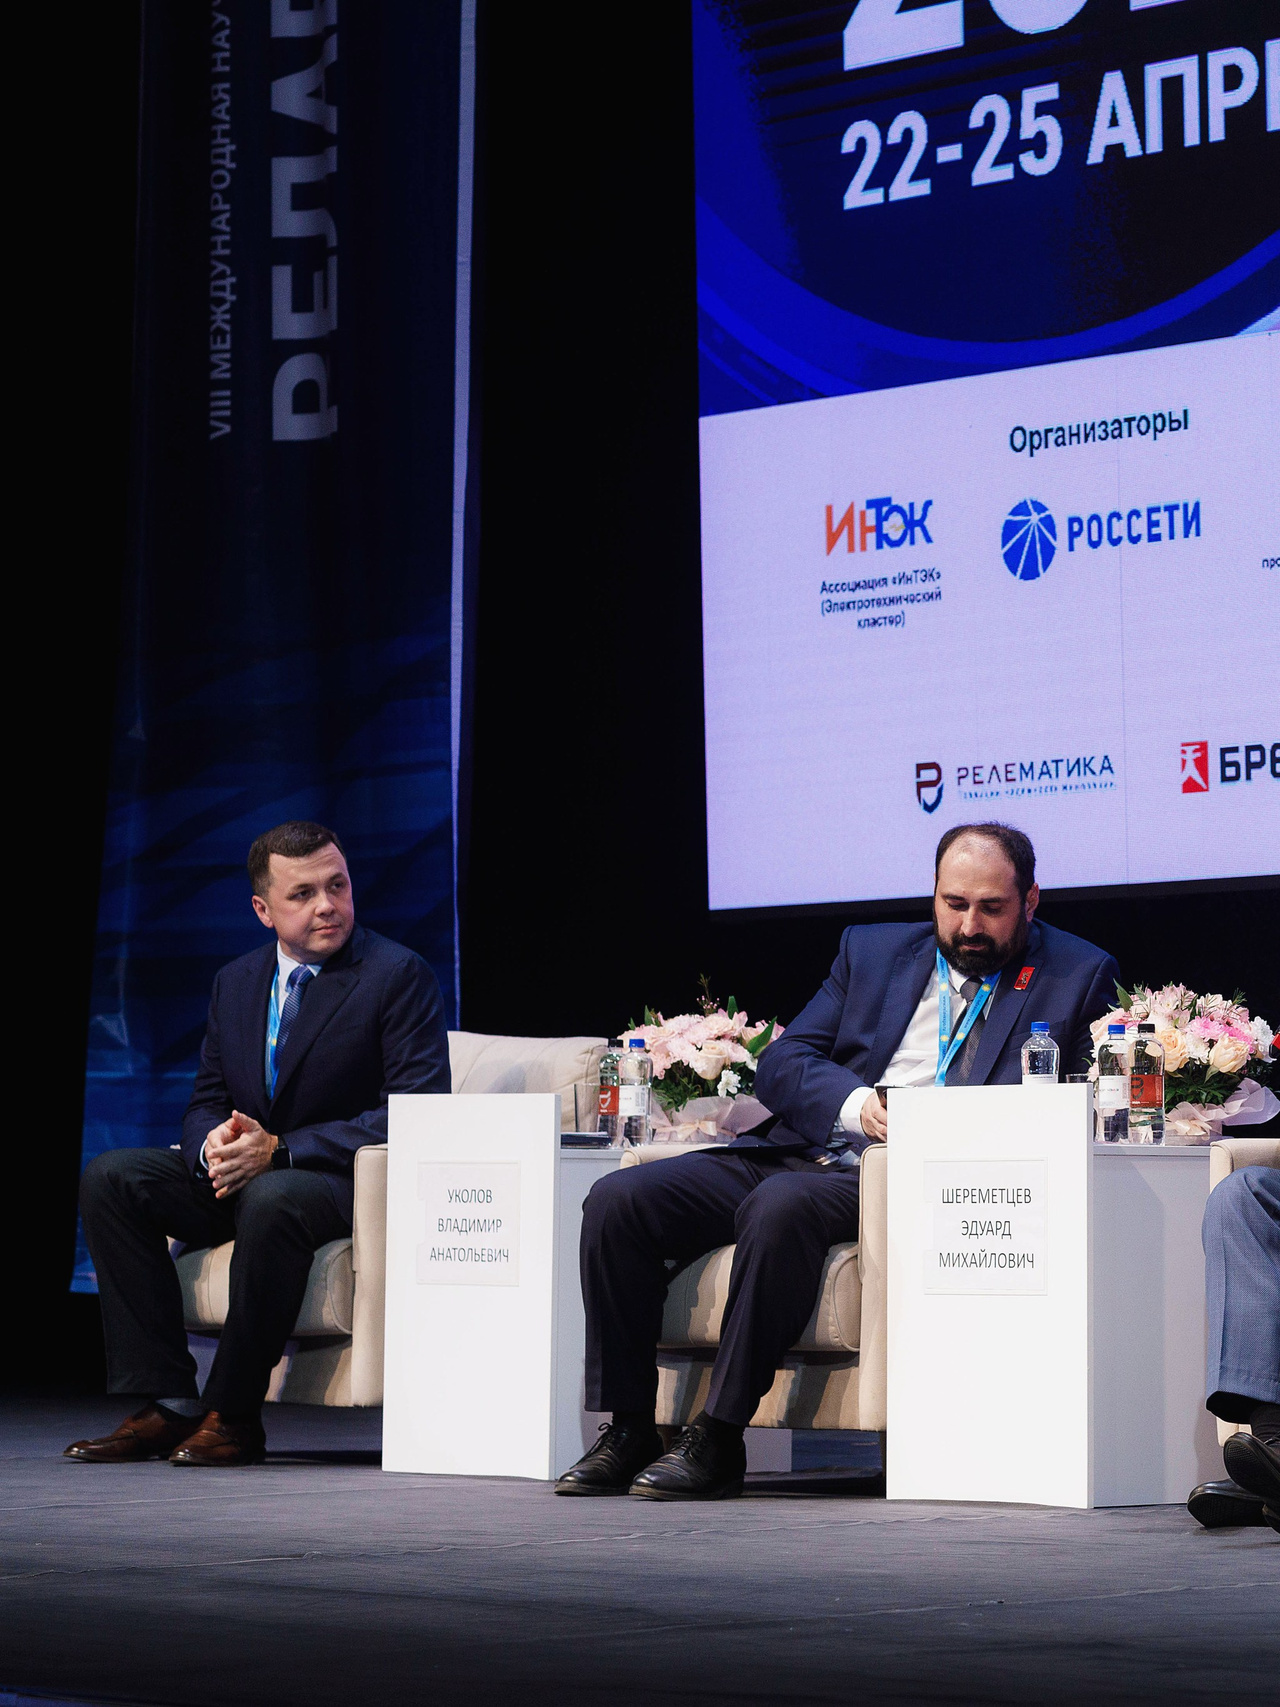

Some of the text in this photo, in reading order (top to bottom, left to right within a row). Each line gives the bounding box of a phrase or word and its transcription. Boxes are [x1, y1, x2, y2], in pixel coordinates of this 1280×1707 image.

[841, 81, 1064, 210] 22-25
[210, 0, 237, 440] VIII МЕЖДУНАРОДНАЯ НАУ
[1009, 408, 1190, 457] Организаторы
[1067, 500, 1202, 552] РОССЕТИ
[820, 567, 942, 594] Ассоциация «ИнТЭК»
[821, 586, 942, 617] (Электротехнический
[857, 610, 905, 629] кластер)
[957, 755, 1115, 786] РЕЛЕМАТИКА
[447, 1188, 493, 1204] УКОЛОВ
[941, 1187, 1033, 1208] ШЕРЕМЕТЦЕВ
[437, 1217, 503, 1236] ВЛАДИМИР
[961, 1220, 1012, 1240] ЭДУАРД
[429, 1247, 510, 1263] АНАТОЛЬЕВИЧ
[938, 1248, 1035, 1269] МИХАЙЛОВИЧ
